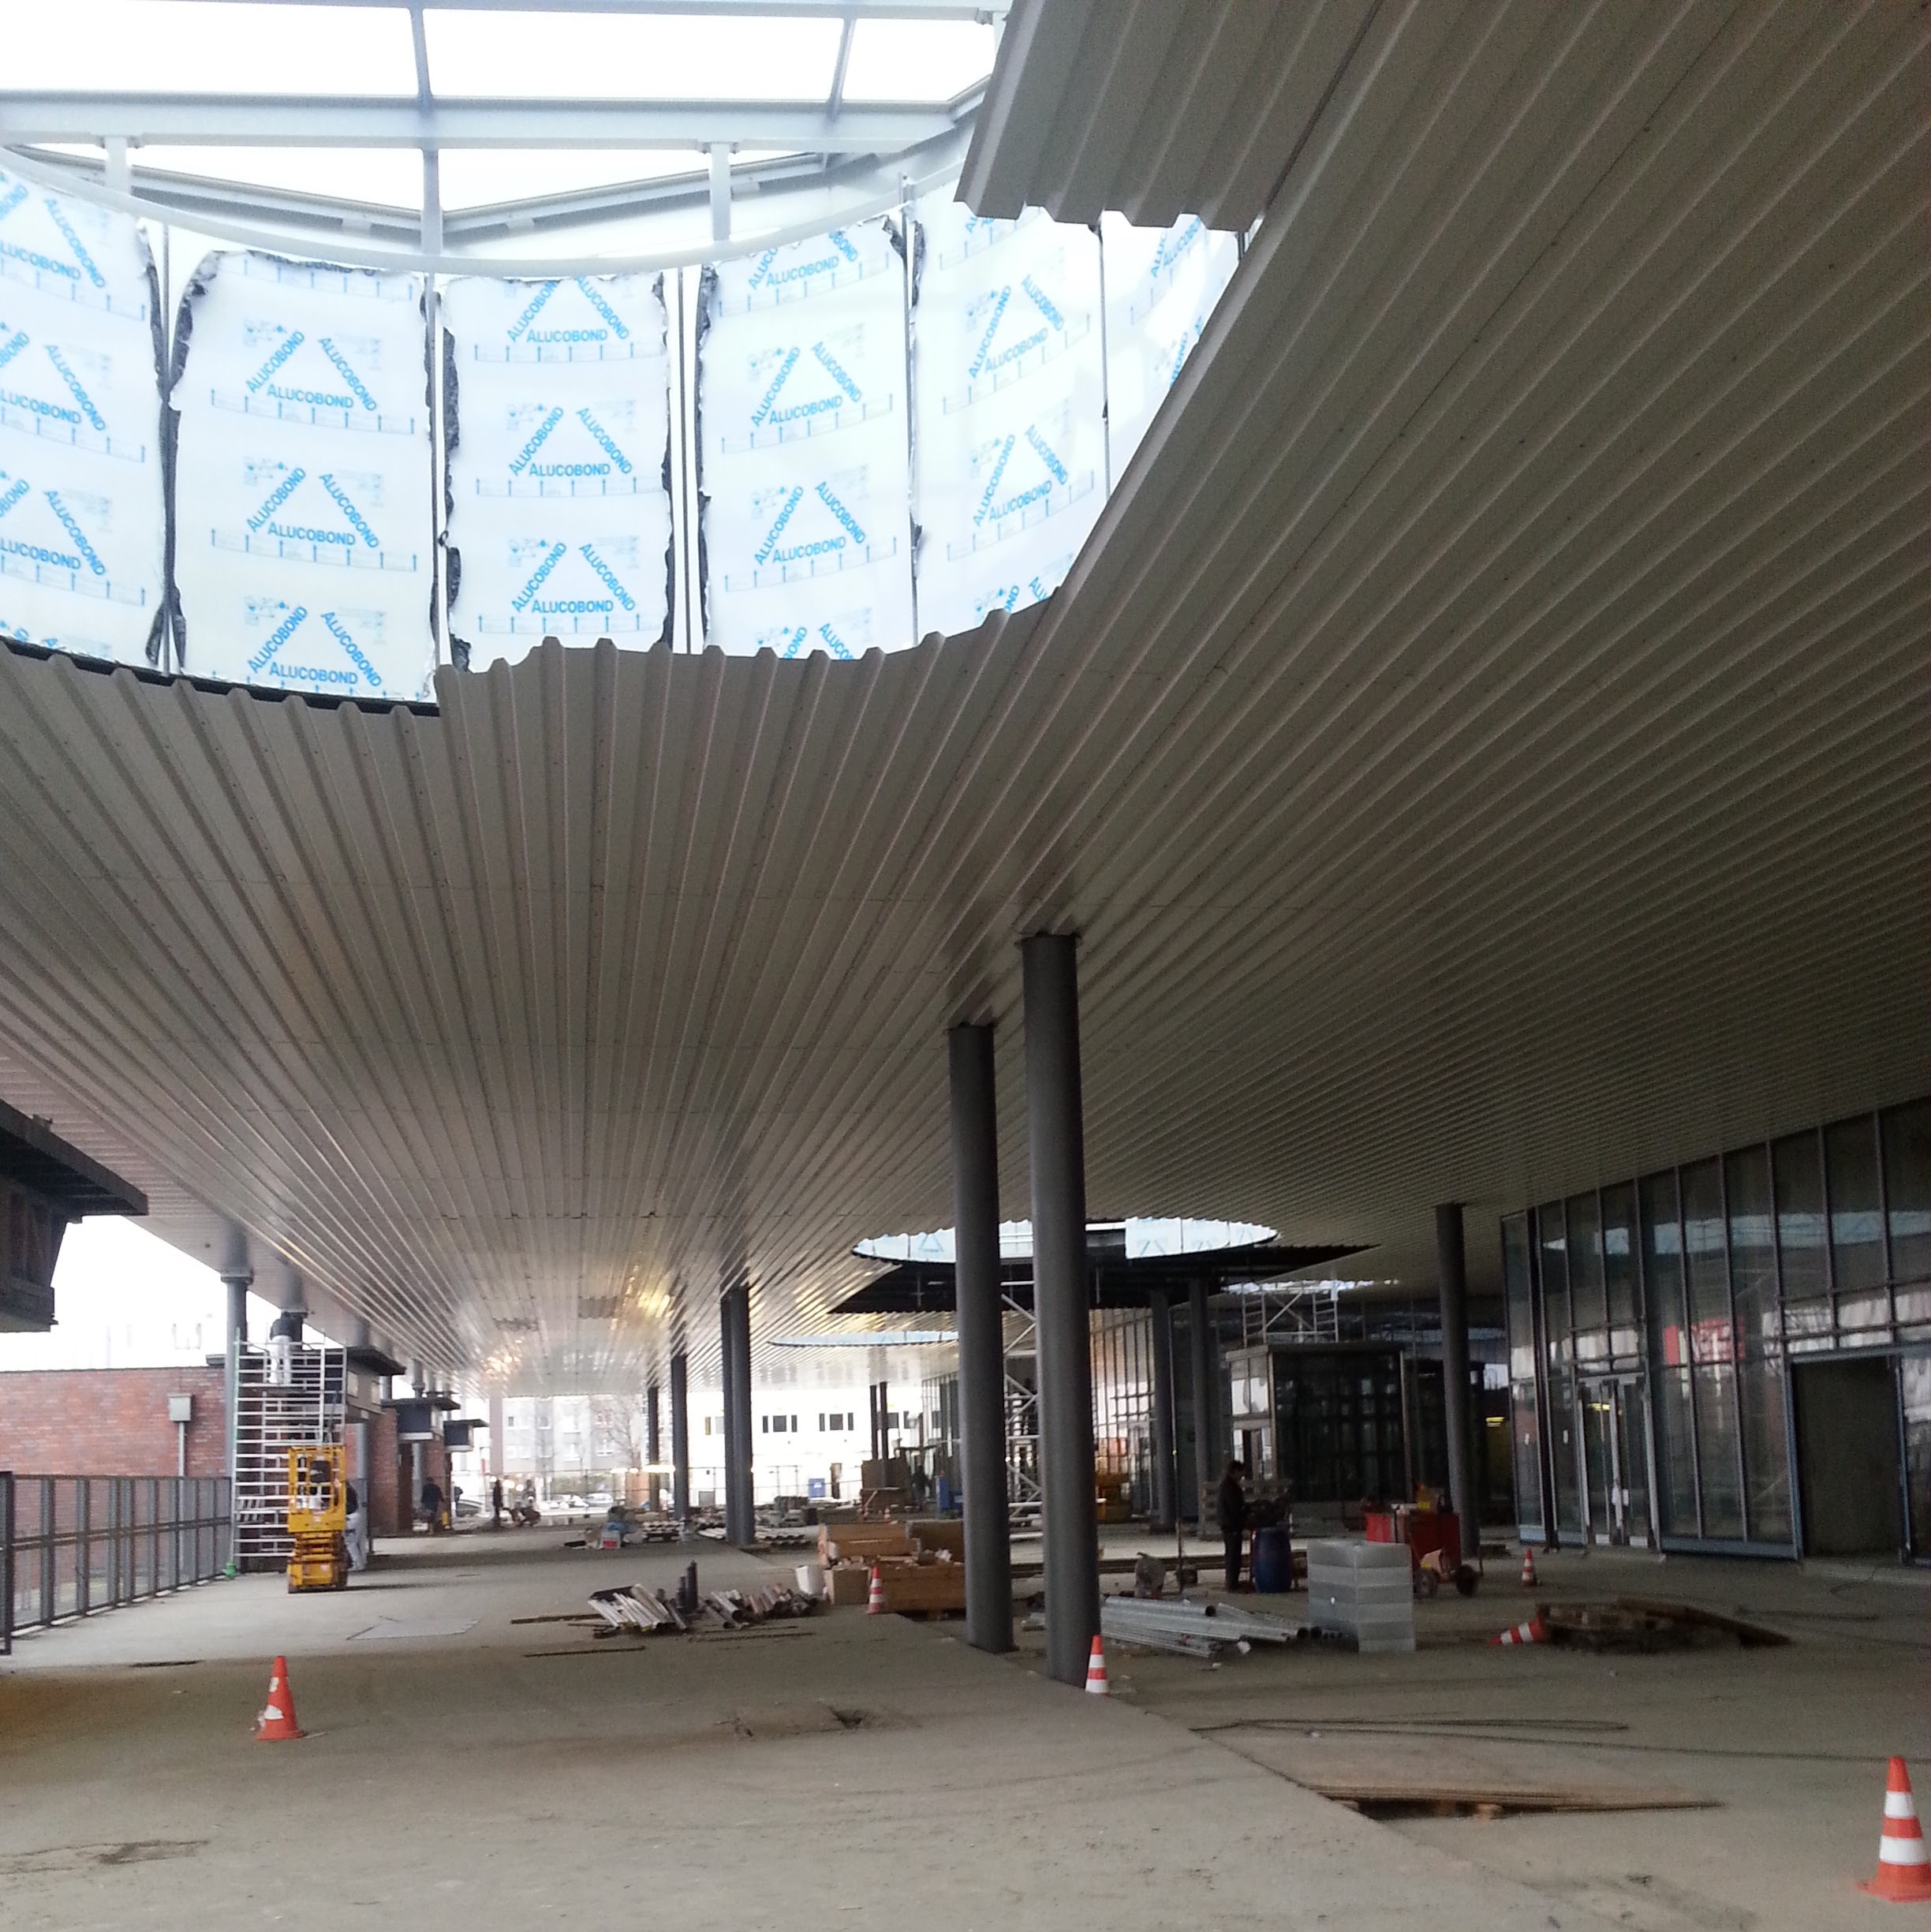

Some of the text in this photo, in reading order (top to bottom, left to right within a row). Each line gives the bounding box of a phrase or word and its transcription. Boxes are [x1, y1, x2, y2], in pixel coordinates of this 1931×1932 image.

[0, 241, 81, 280] LUCOBOND
[44, 199, 106, 289] ALUCOBOND
[765, 256, 840, 286] ALUCOBOND
[507, 280, 558, 342] ALUCOBON
[968, 286, 1010, 379] ALUCOBOND
[1021, 275, 1063, 331] ALUCOBOND
[246, 331, 304, 393] ALUCOBOND
[527, 328, 608, 342] ALUCOBOND
[984, 328, 1048, 373] ALUCOBOND
[45, 345, 106, 432] ALUCOBOND
[267, 384, 354, 409] ALUCOBOND
[319, 338, 377, 412] ALUCOBOND
[751, 346, 799, 428] ALUCOBOND
[812, 342, 861, 403] ALUCOBOND
[0, 387, 82, 426] LUCOBOND
[769, 396, 842, 425] ALUCOBOND
[510, 406, 564, 476] ALUCOBOND
[529, 462, 611, 476] ALUCOBOND
[577, 408, 632, 474] ALUCOBOND
[1026, 426, 1067, 485] ALUCOBOND
[247, 467, 305, 533] ALUCOBOND
[320, 473, 379, 549] ALUCOBOND
[973, 434, 1014, 527] ALUCOBOND
[988, 480, 1052, 521] ALUCOBOND
[45, 490, 106, 577] ALUCOBOND
[267, 521, 357, 546] ALUCOBOND
[754, 486, 803, 566] ALUCOBOND
[816, 482, 865, 545] ALUCOBOND
[0, 536, 82, 570] LUCOBOND
[511, 542, 566, 612] ALUCOBOND
[580, 544, 635, 611] ALUCOBOND
[773, 536, 846, 563] ALUCOBOND
[532, 600, 614, 614] ALUCOBOND
[248, 606, 308, 674] ALUCOBOND
[322, 612, 382, 688] ALUCOBOND
[270, 662, 358, 685] ALUCOBOND
